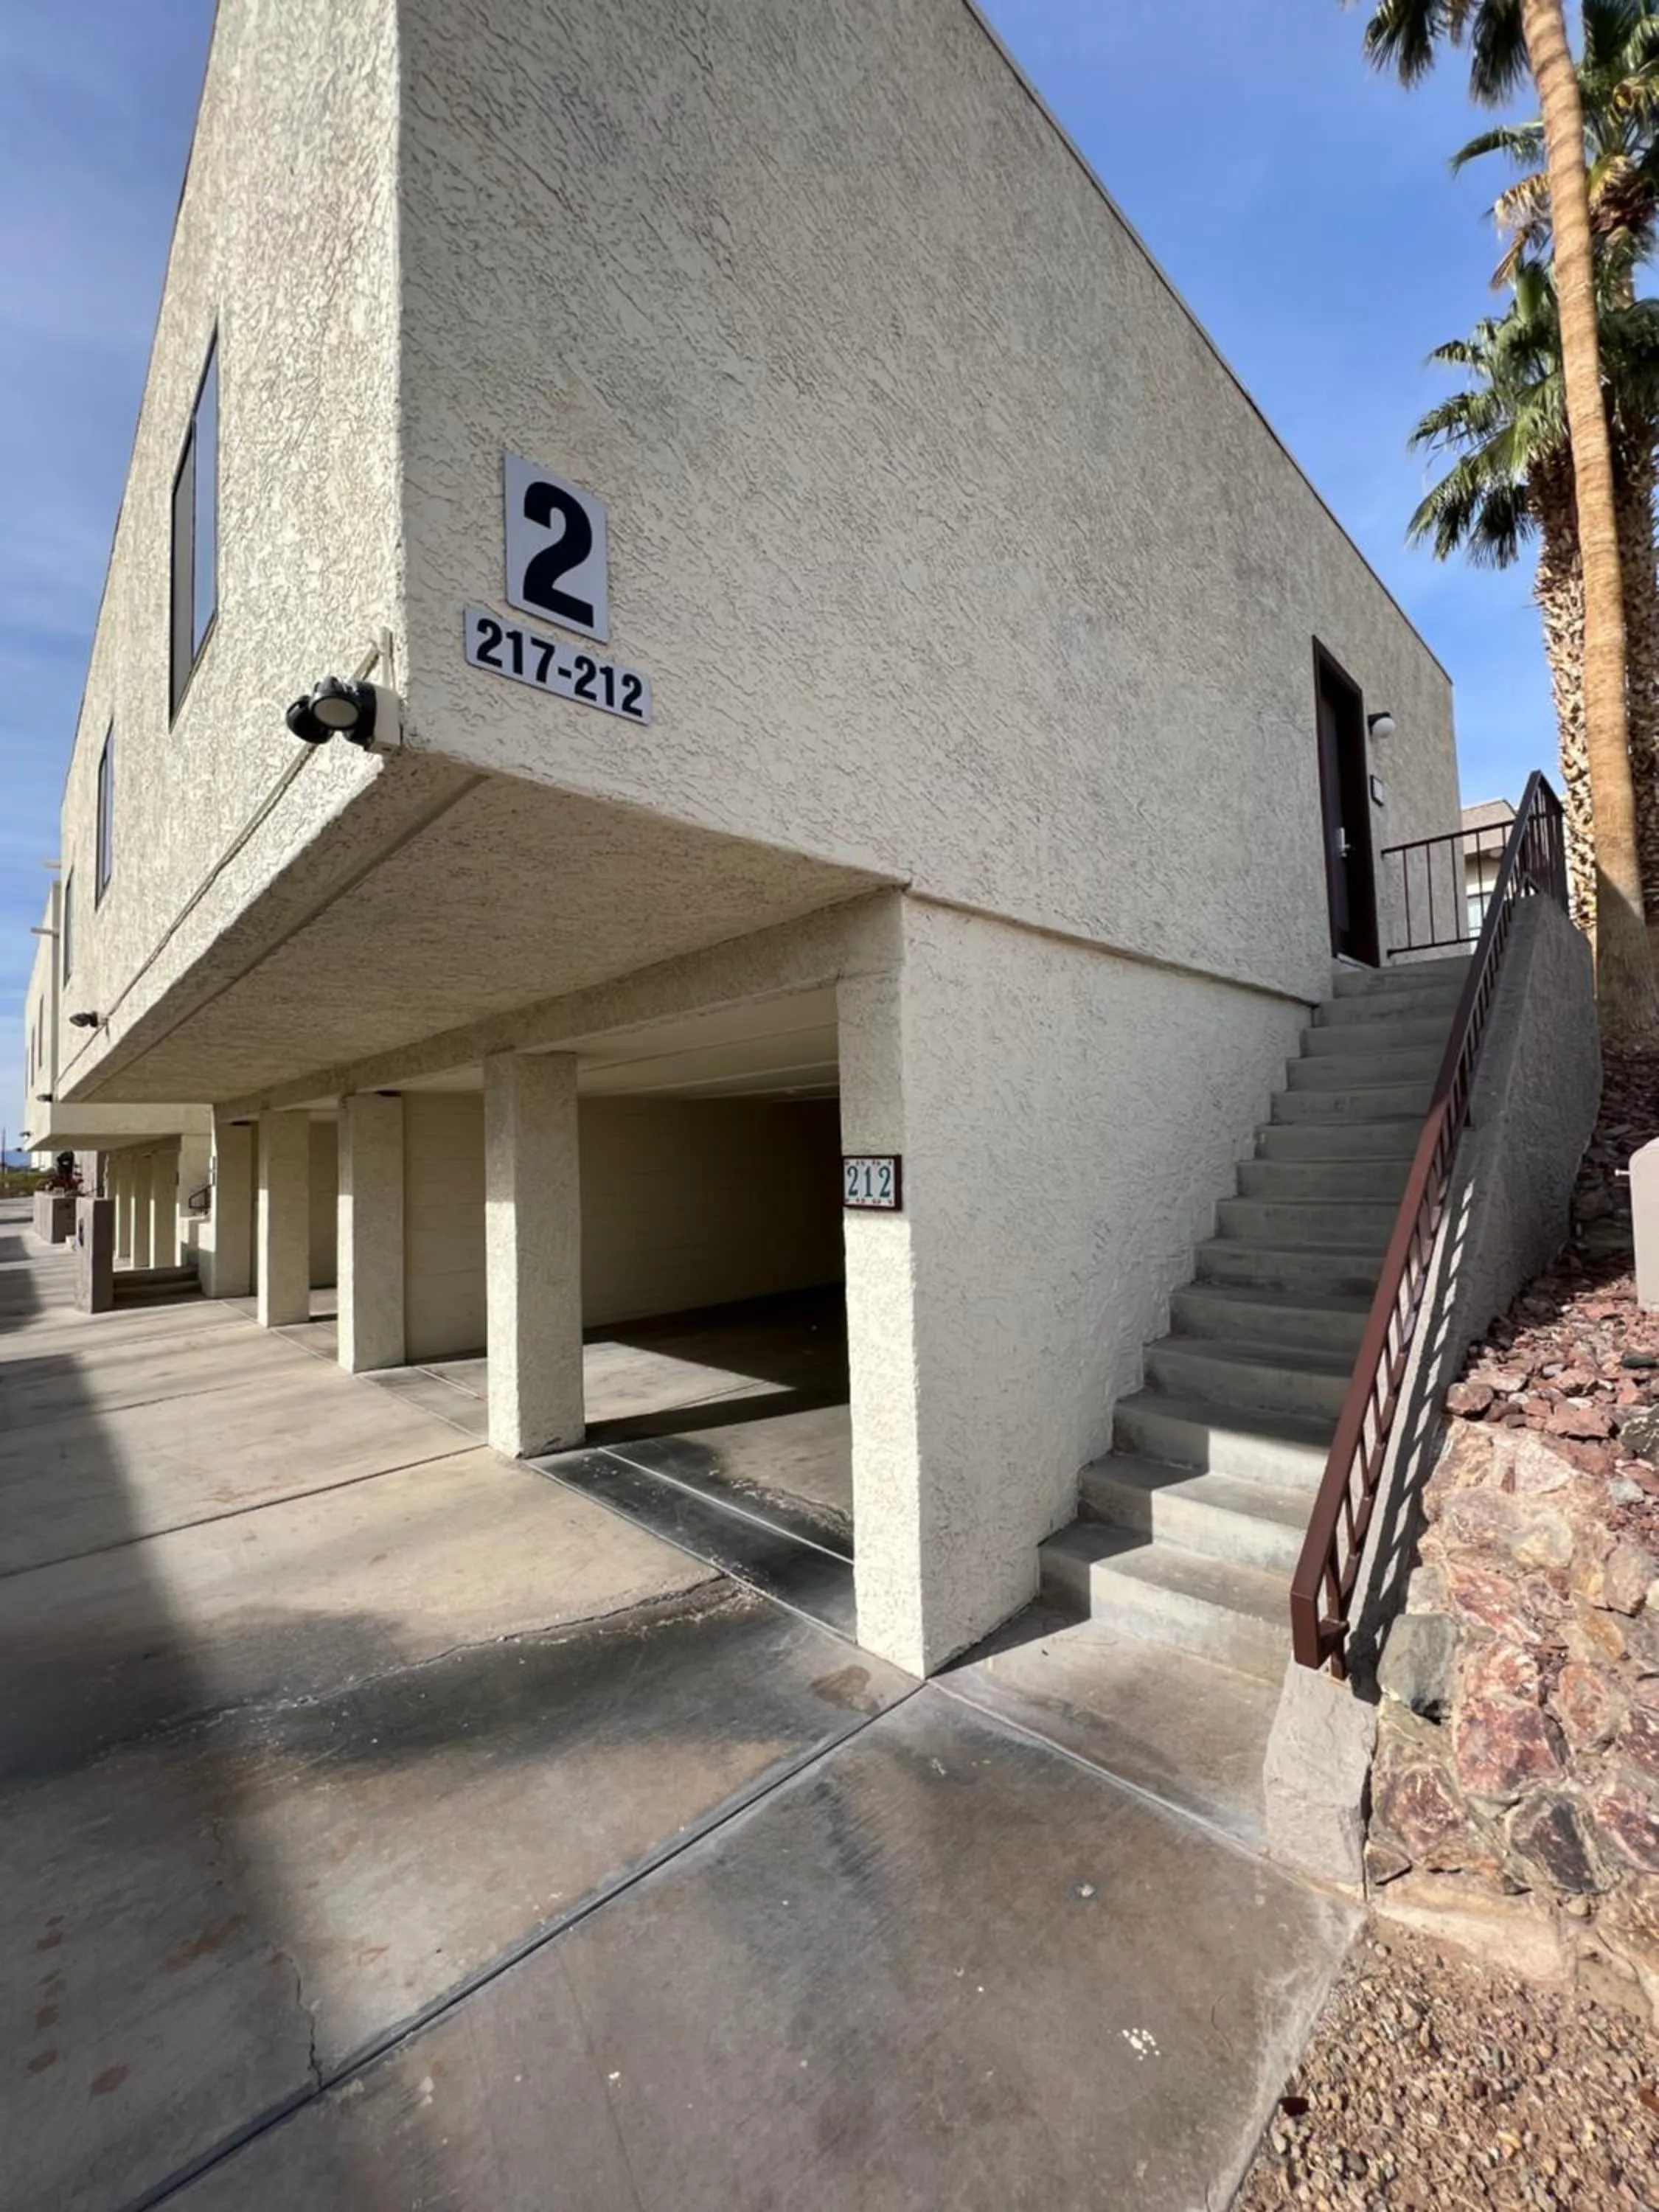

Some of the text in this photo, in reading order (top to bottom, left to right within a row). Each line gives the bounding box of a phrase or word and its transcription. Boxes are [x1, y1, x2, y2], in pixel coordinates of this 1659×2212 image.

[524, 481, 594, 628] 2
[476, 618, 643, 718] 217-212
[847, 1166, 891, 1197] 212
